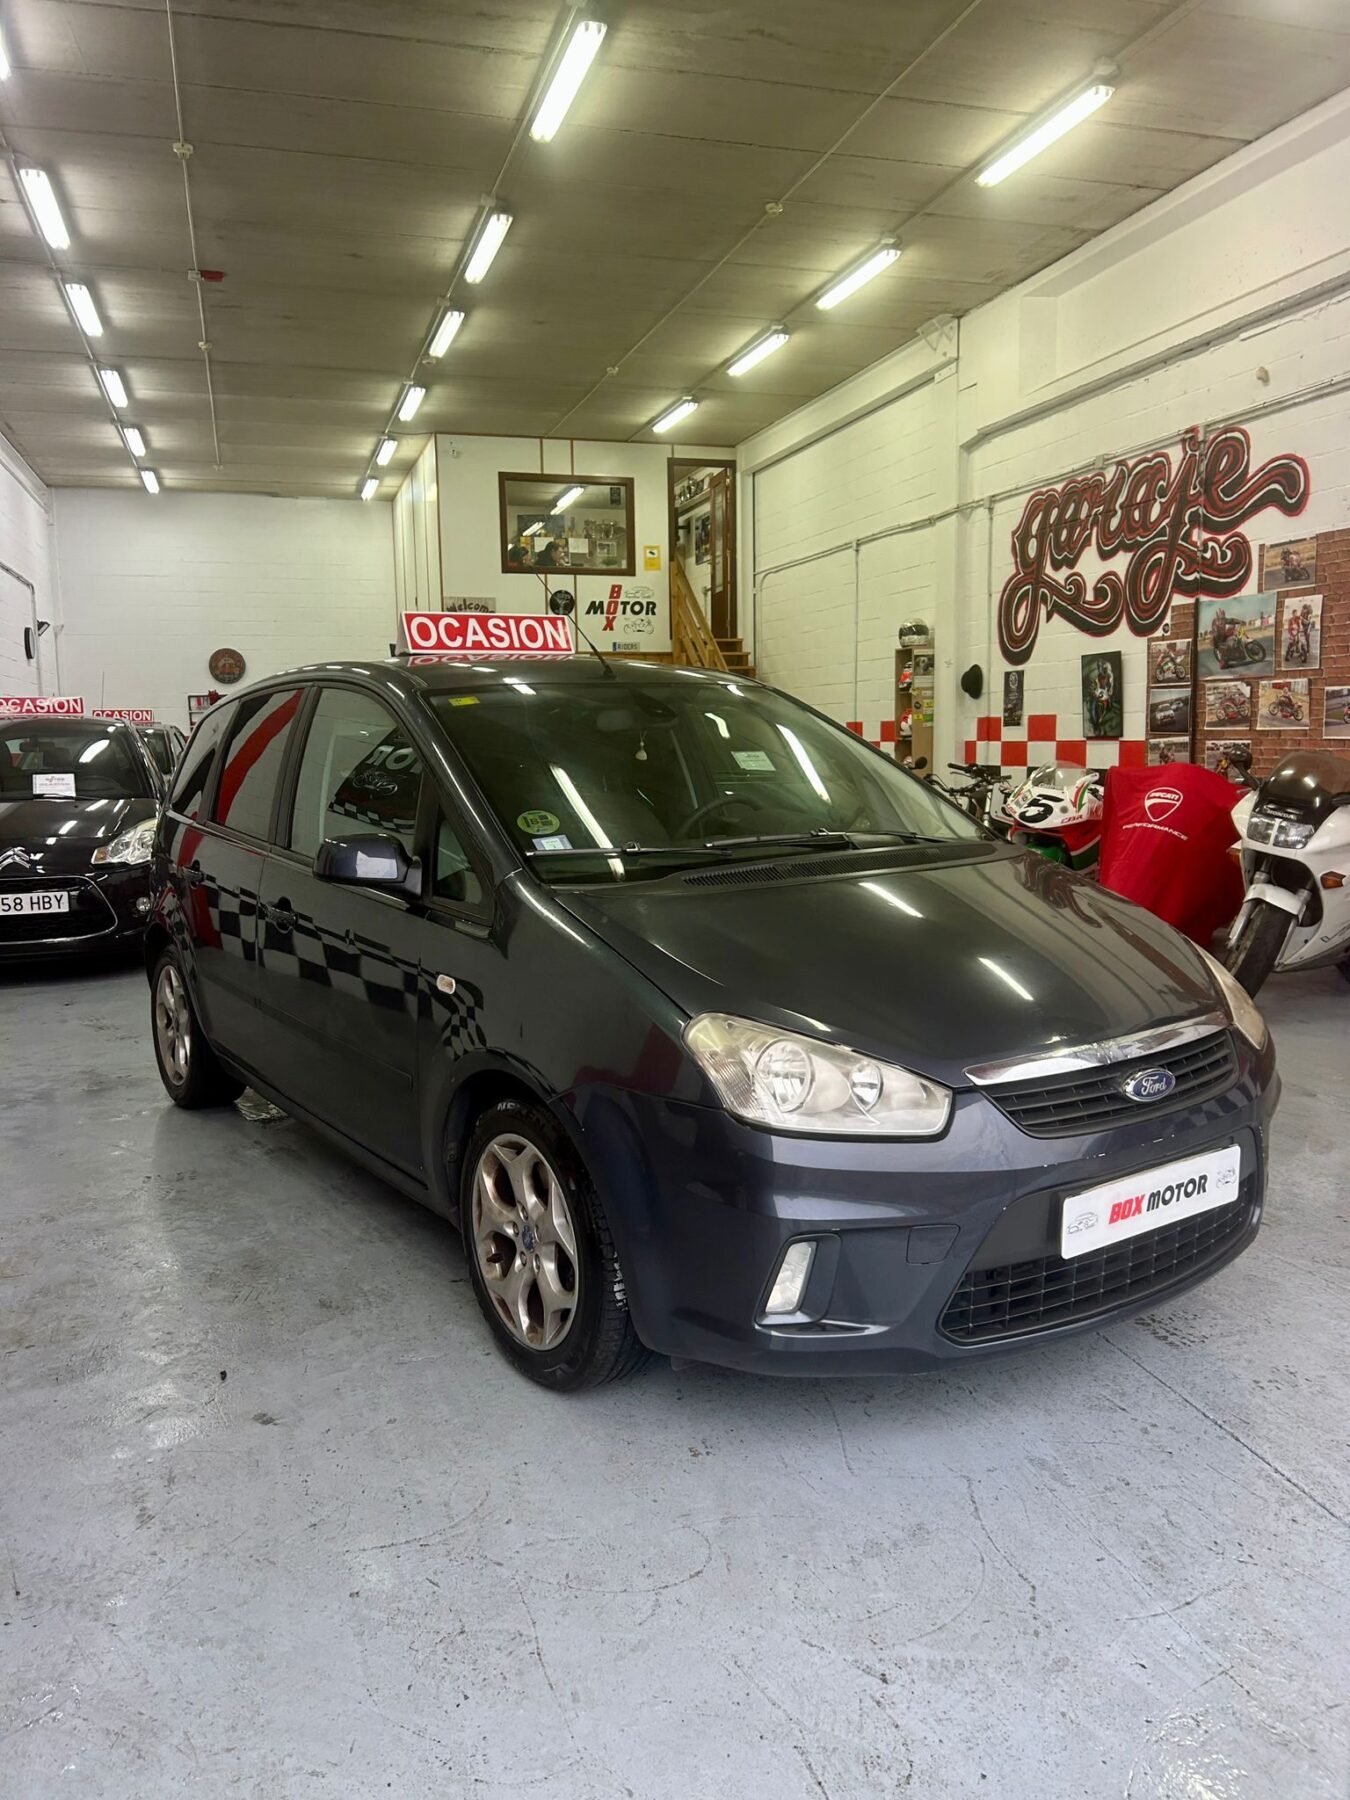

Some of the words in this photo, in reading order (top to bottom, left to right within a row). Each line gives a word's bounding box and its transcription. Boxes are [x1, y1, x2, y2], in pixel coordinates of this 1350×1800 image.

[585, 600, 657, 616] MOTOR
[602, 584, 623, 631] BOX
[410, 616, 571, 650] OCASION
[0, 699, 82, 713] OCASION
[93, 710, 151, 722] OCASION
[1149, 792, 1180, 801] DUCATI
[1019, 793, 1065, 824] 5
[1, 897, 24, 912] 58
[29, 894, 64, 911] HBY
[1140, 1075, 1168, 1096] Ford
[1108, 1193, 1146, 1225] BOX
[1146, 1174, 1209, 1212] MOTOR
